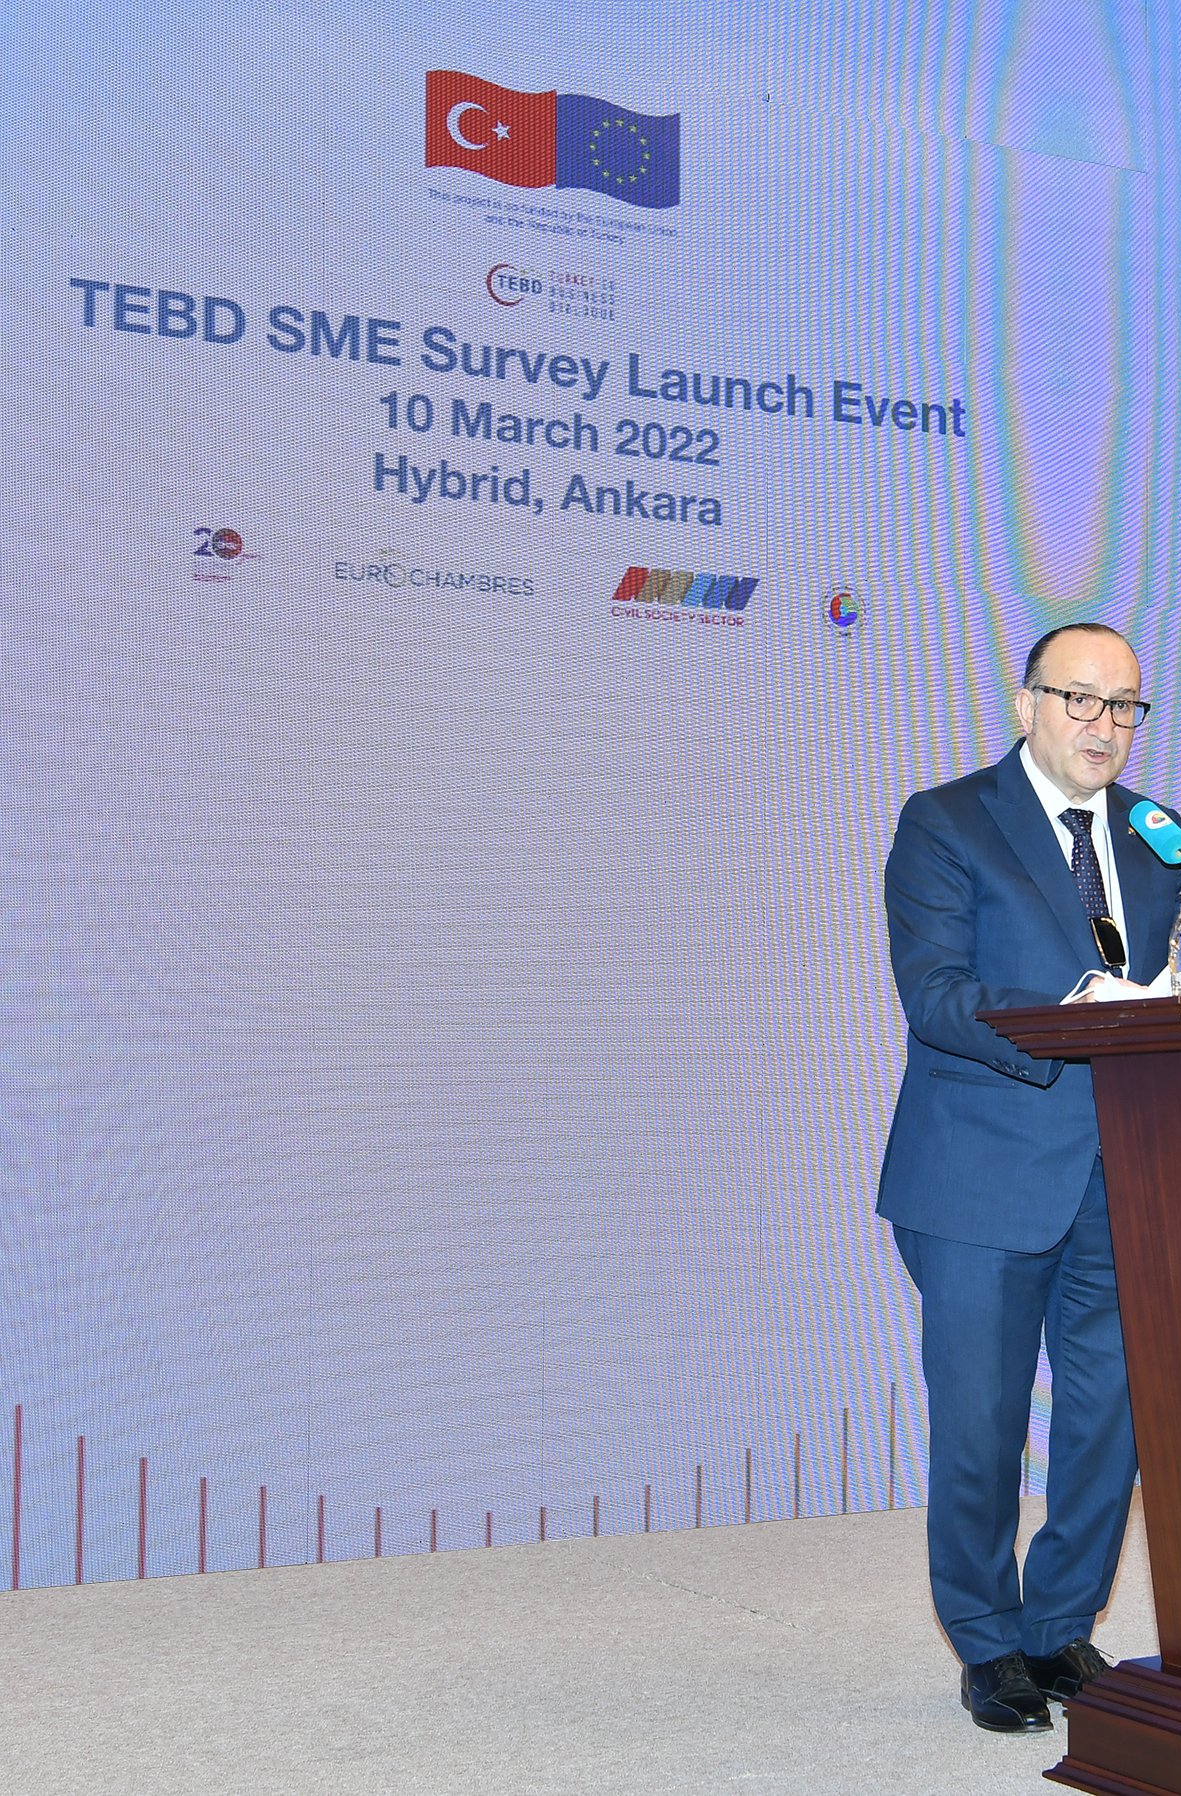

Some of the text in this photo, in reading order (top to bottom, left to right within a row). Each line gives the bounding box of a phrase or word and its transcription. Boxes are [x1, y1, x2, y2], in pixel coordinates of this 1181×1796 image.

[497, 274, 543, 295] TEBD
[69, 277, 967, 438] TEBD SME Survey Launch Event
[380, 390, 721, 467] 10 March 2022
[372, 451, 723, 527] Hybrid, Ankara
[611, 606, 746, 627] CIVIL SOCIETY SECTOR
